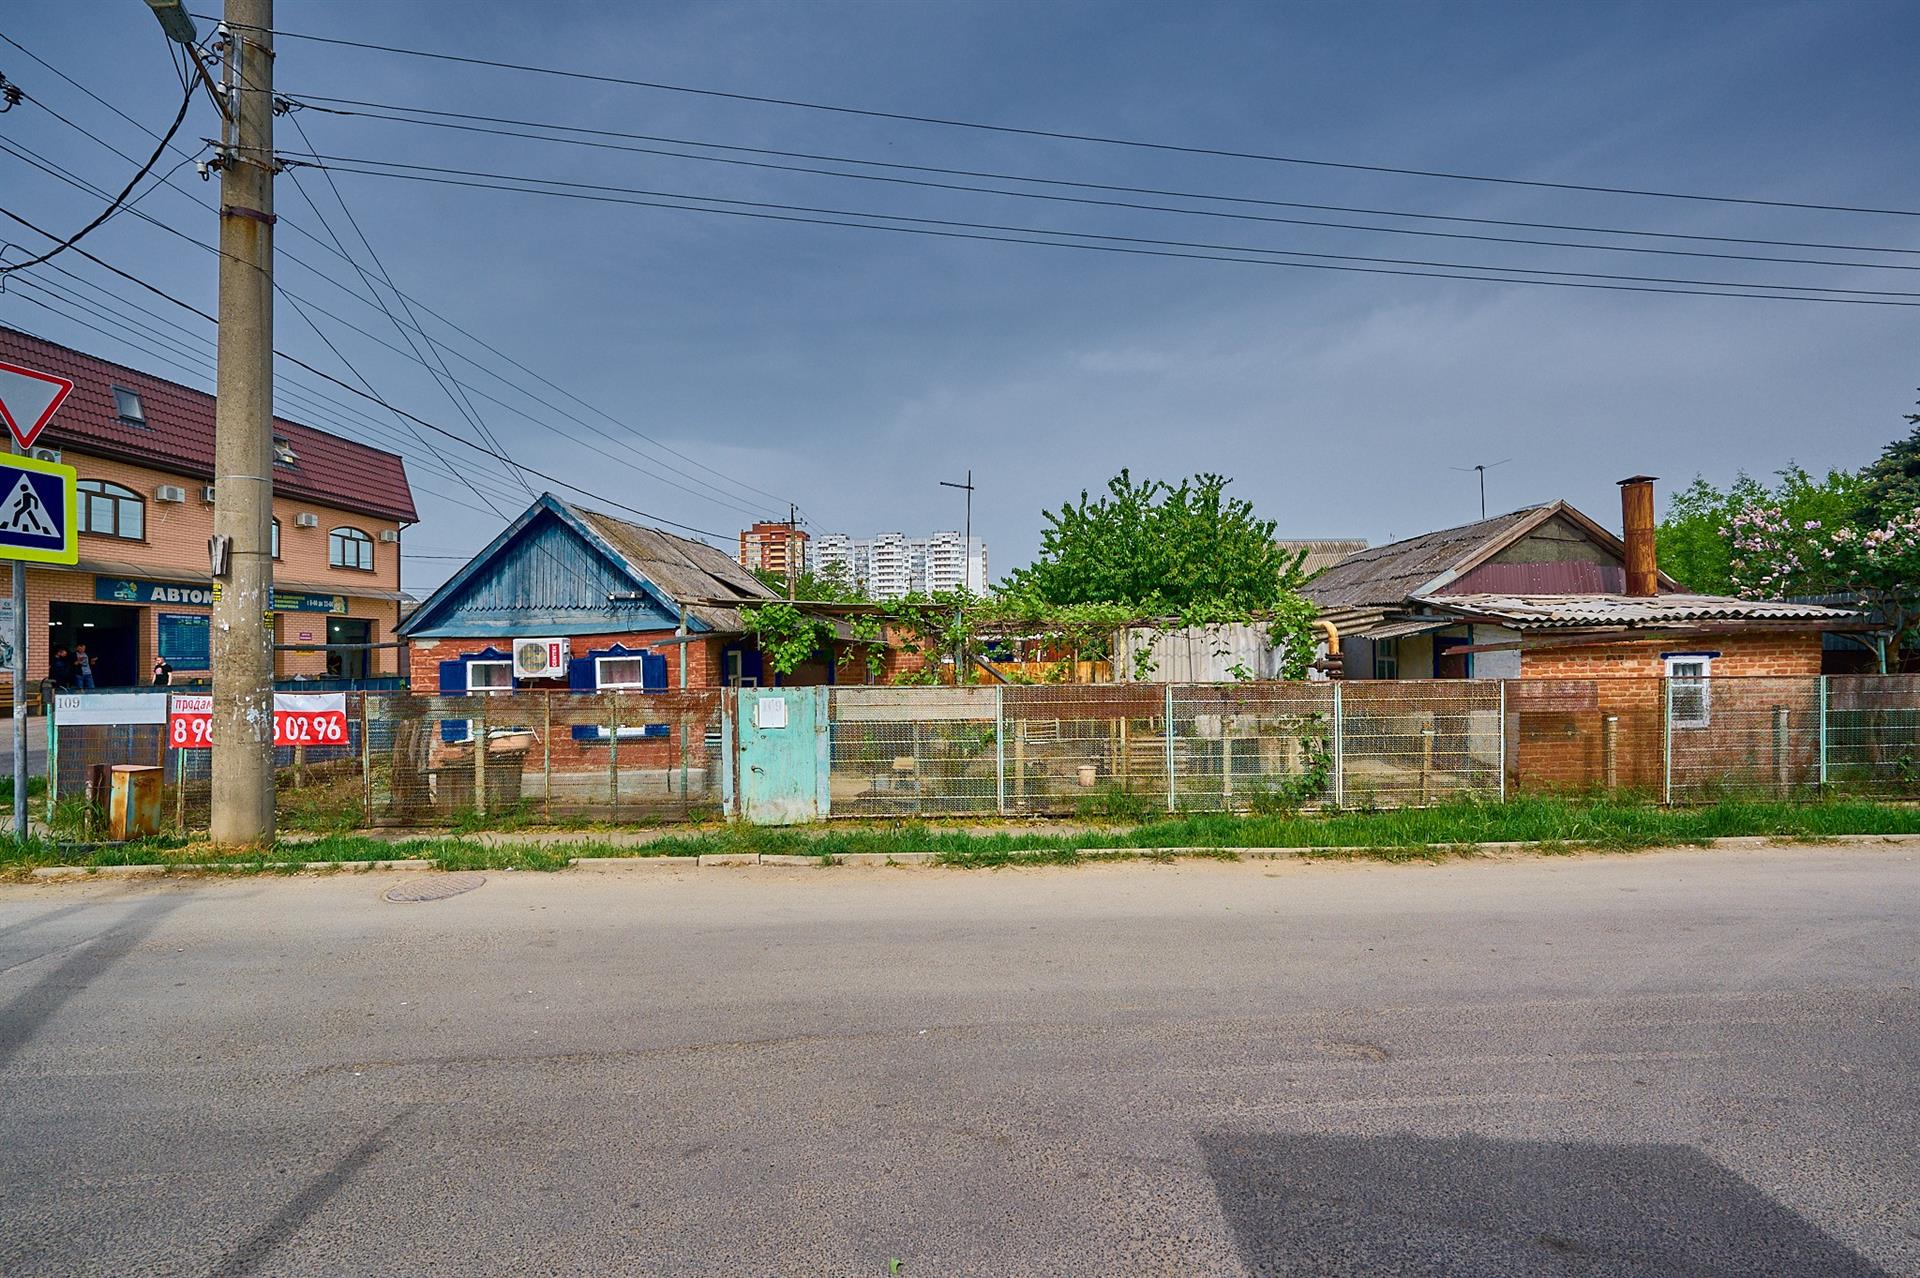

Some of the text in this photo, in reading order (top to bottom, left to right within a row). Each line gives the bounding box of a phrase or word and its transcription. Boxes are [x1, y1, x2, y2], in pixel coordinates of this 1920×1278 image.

[58, 697, 80, 709] 109
[174, 718, 187, 743] 8
[285, 716, 311, 741] 02
[313, 716, 341, 741] 96
